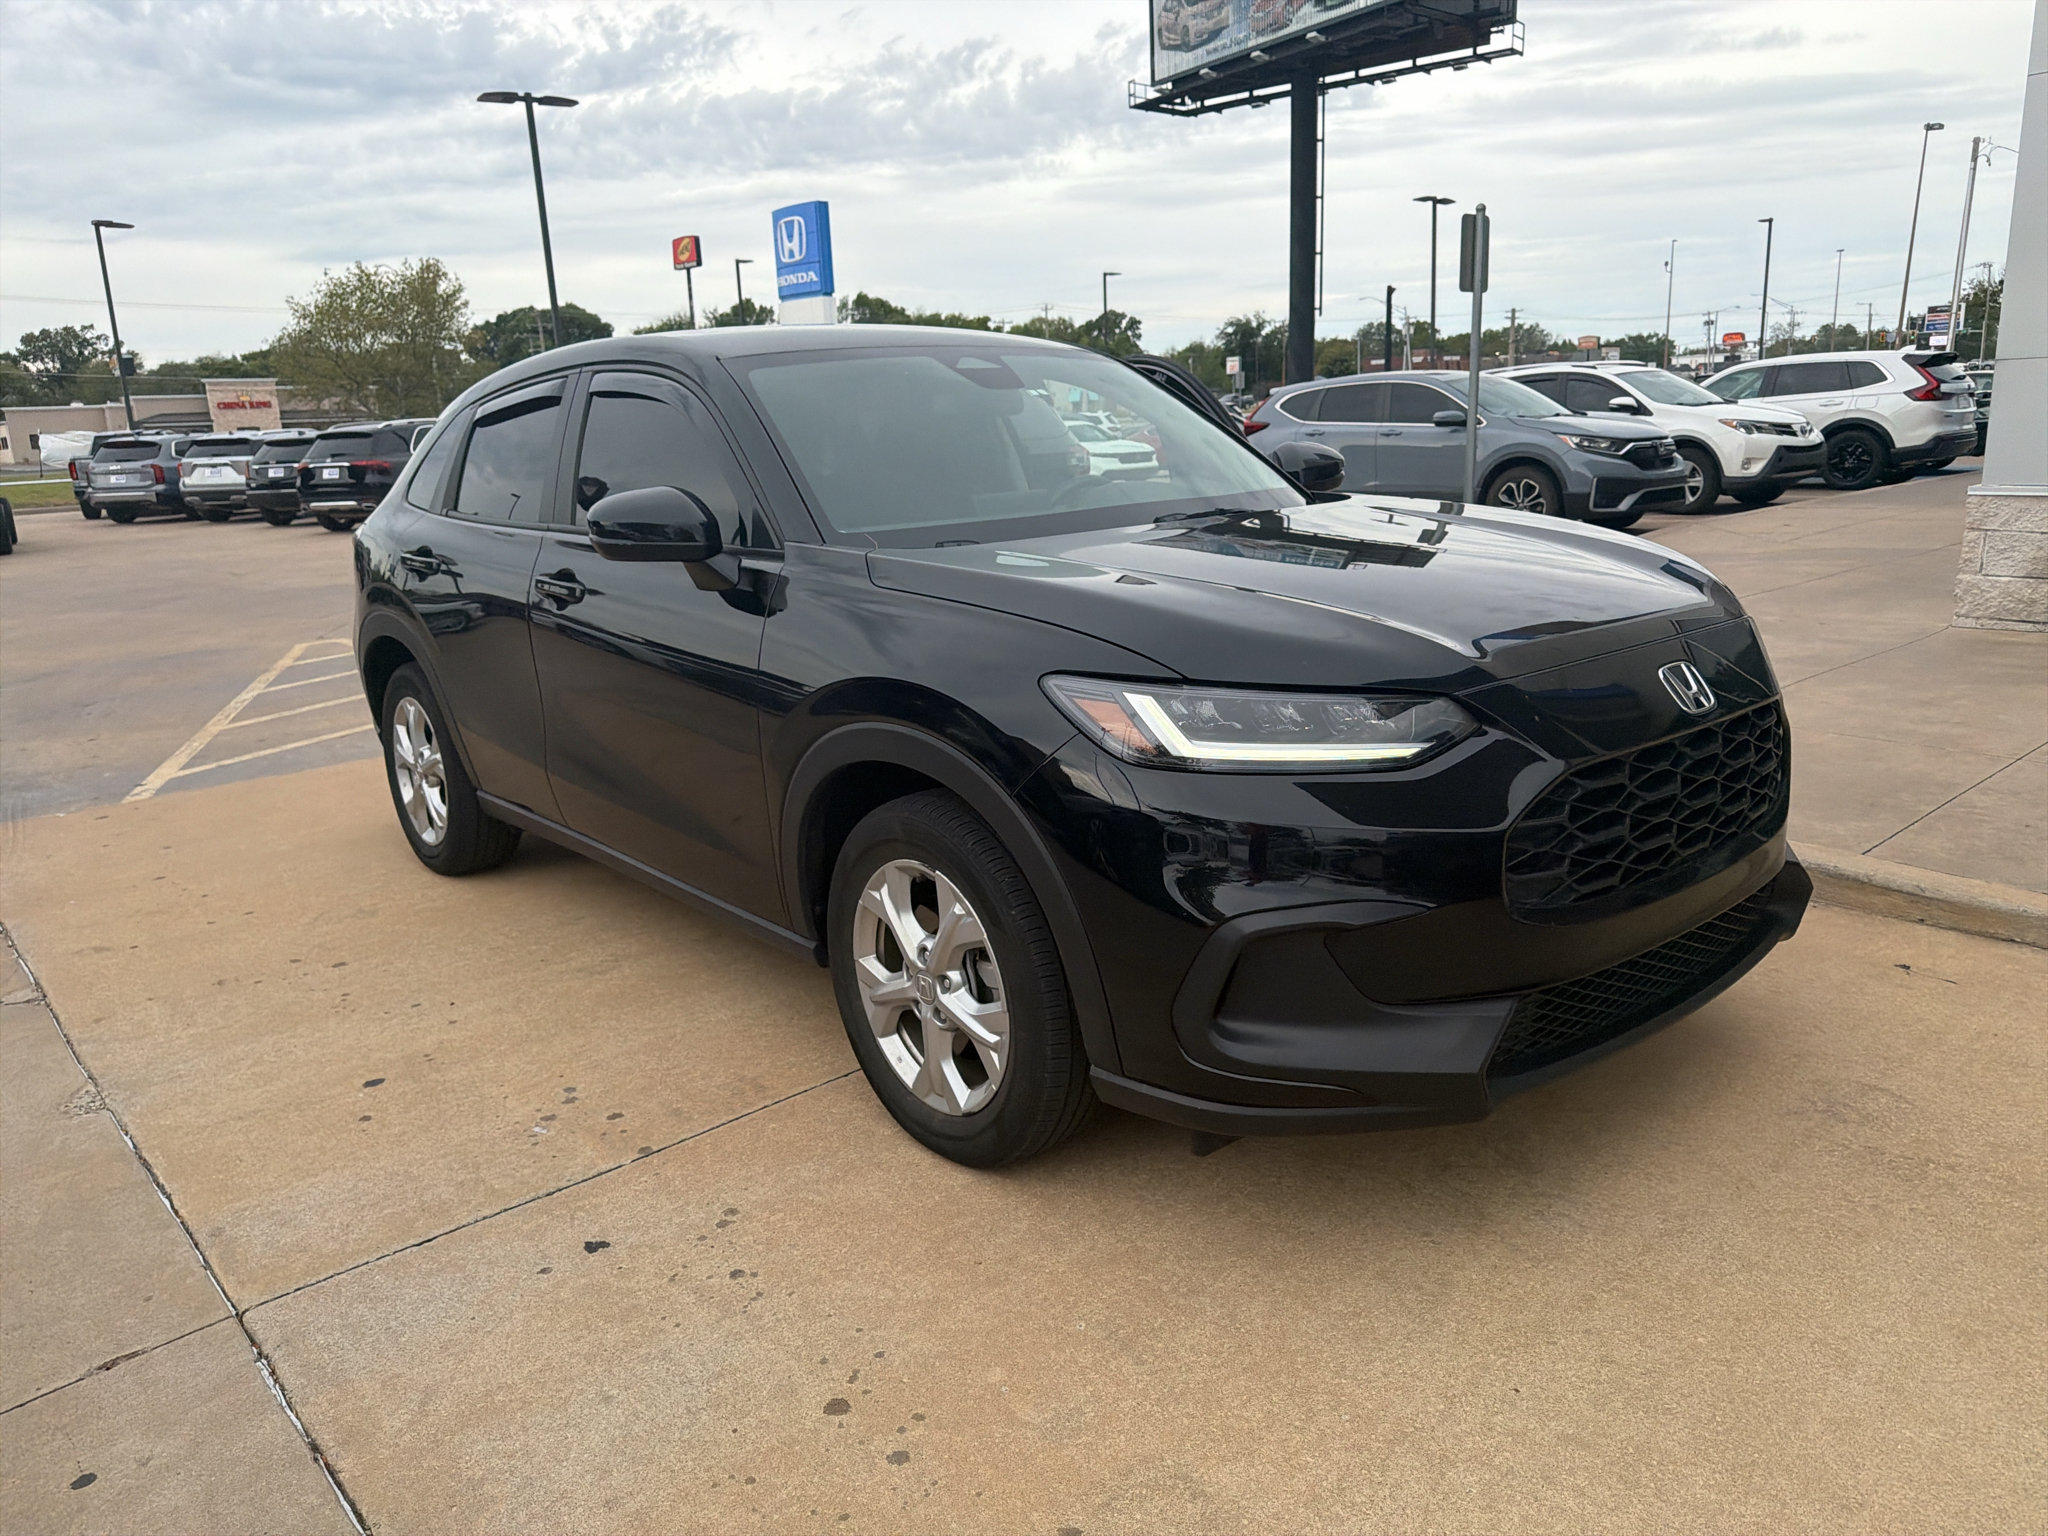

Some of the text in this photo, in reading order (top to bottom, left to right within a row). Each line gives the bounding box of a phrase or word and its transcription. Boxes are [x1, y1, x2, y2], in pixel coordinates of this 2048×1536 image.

[777, 271, 819, 287] HONDA
[216, 400, 272, 410] CHINA KING
